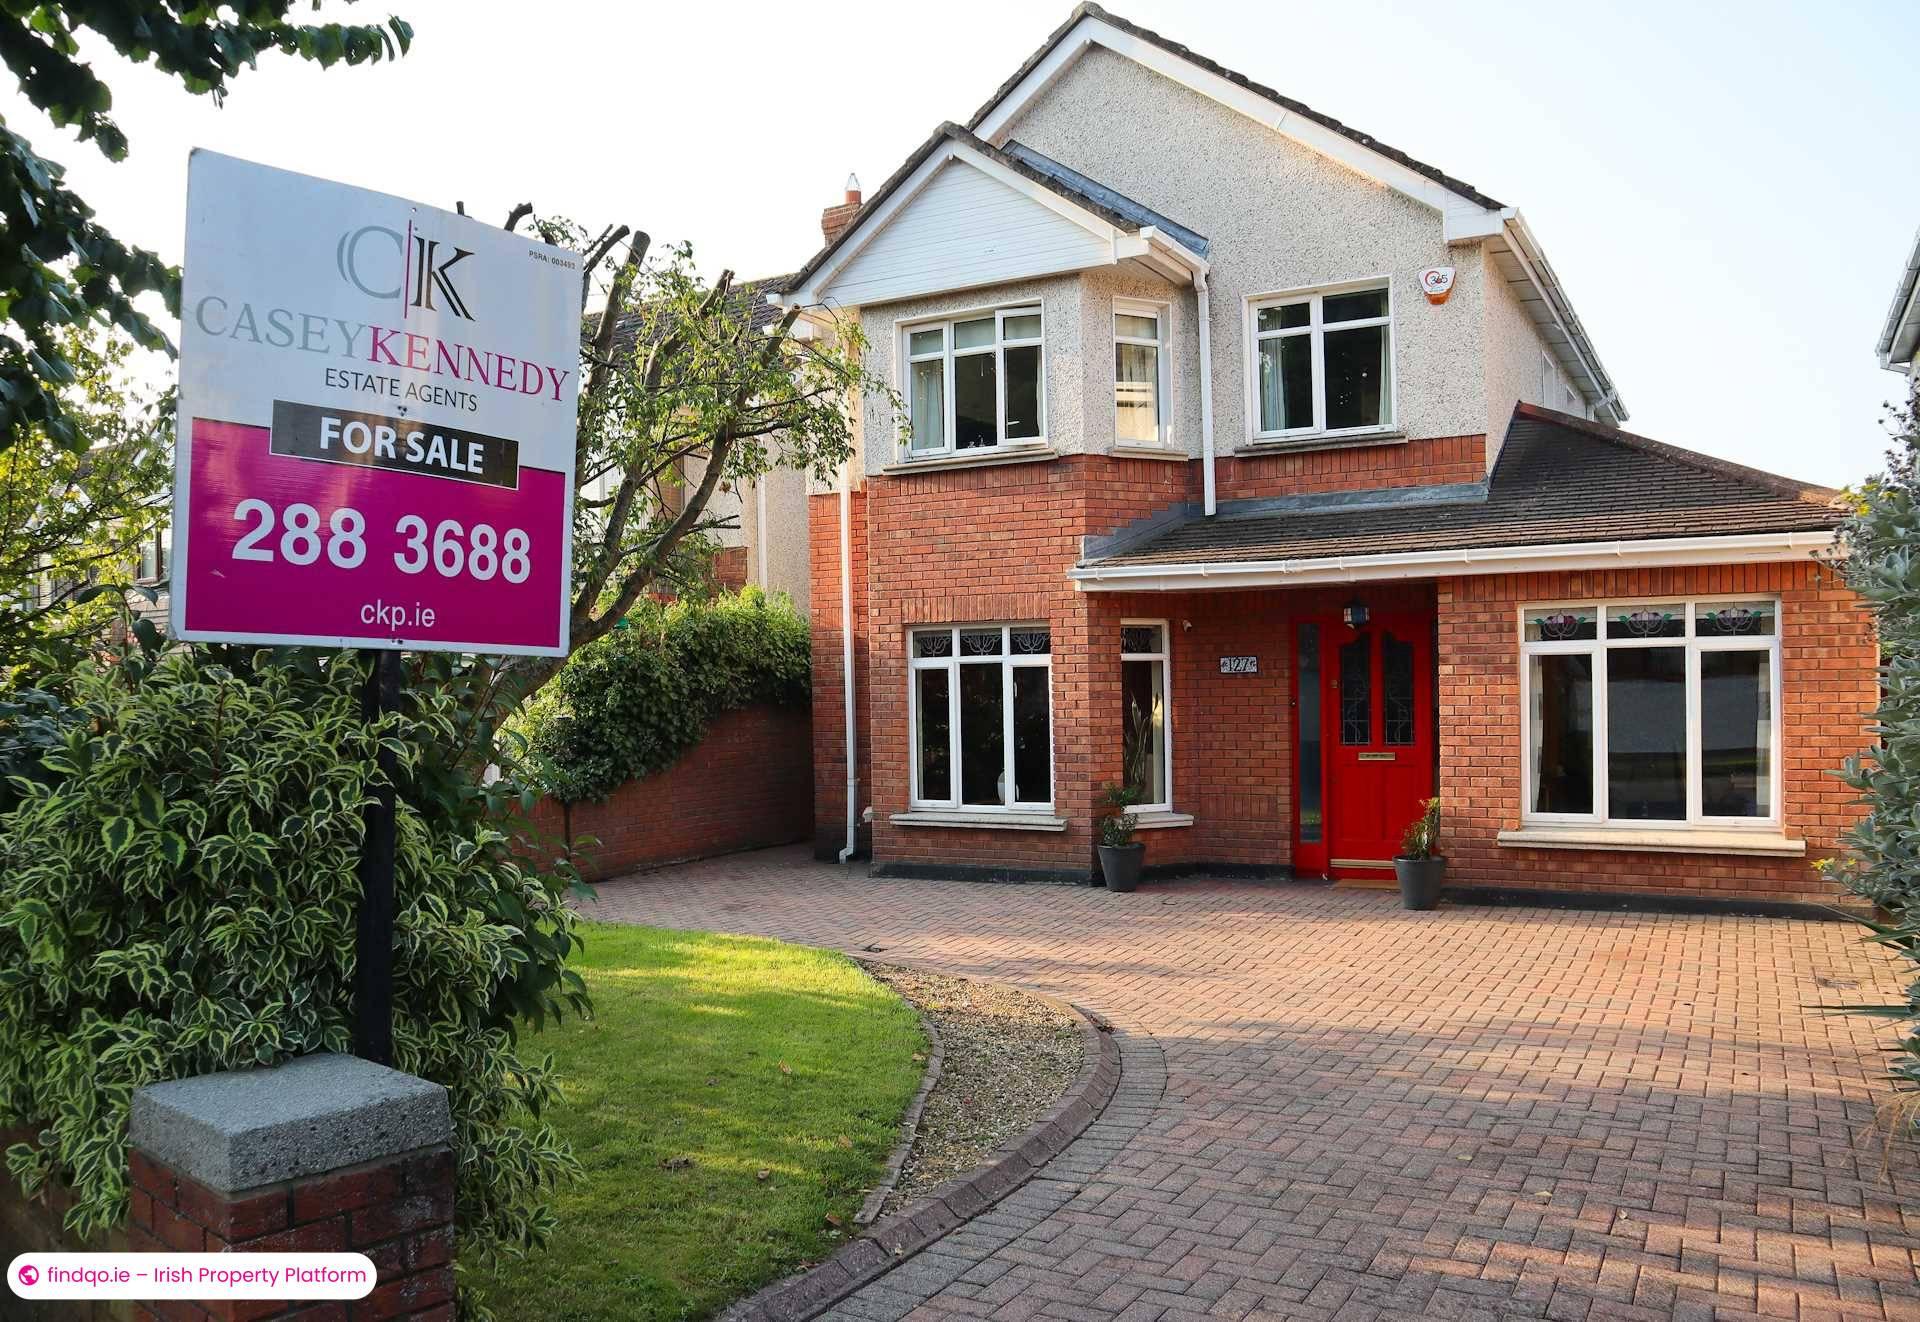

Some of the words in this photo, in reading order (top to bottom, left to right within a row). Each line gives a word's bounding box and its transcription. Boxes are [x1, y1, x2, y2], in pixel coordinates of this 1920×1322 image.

[325, 367, 400, 397] ESTATE
[405, 381, 478, 412] AGENTS
[319, 416, 397, 459] FOR
[405, 431, 484, 474] SALE
[232, 498, 367, 569] 288
[393, 514, 531, 584] 3688
[360, 599, 436, 631] ckp.ie
